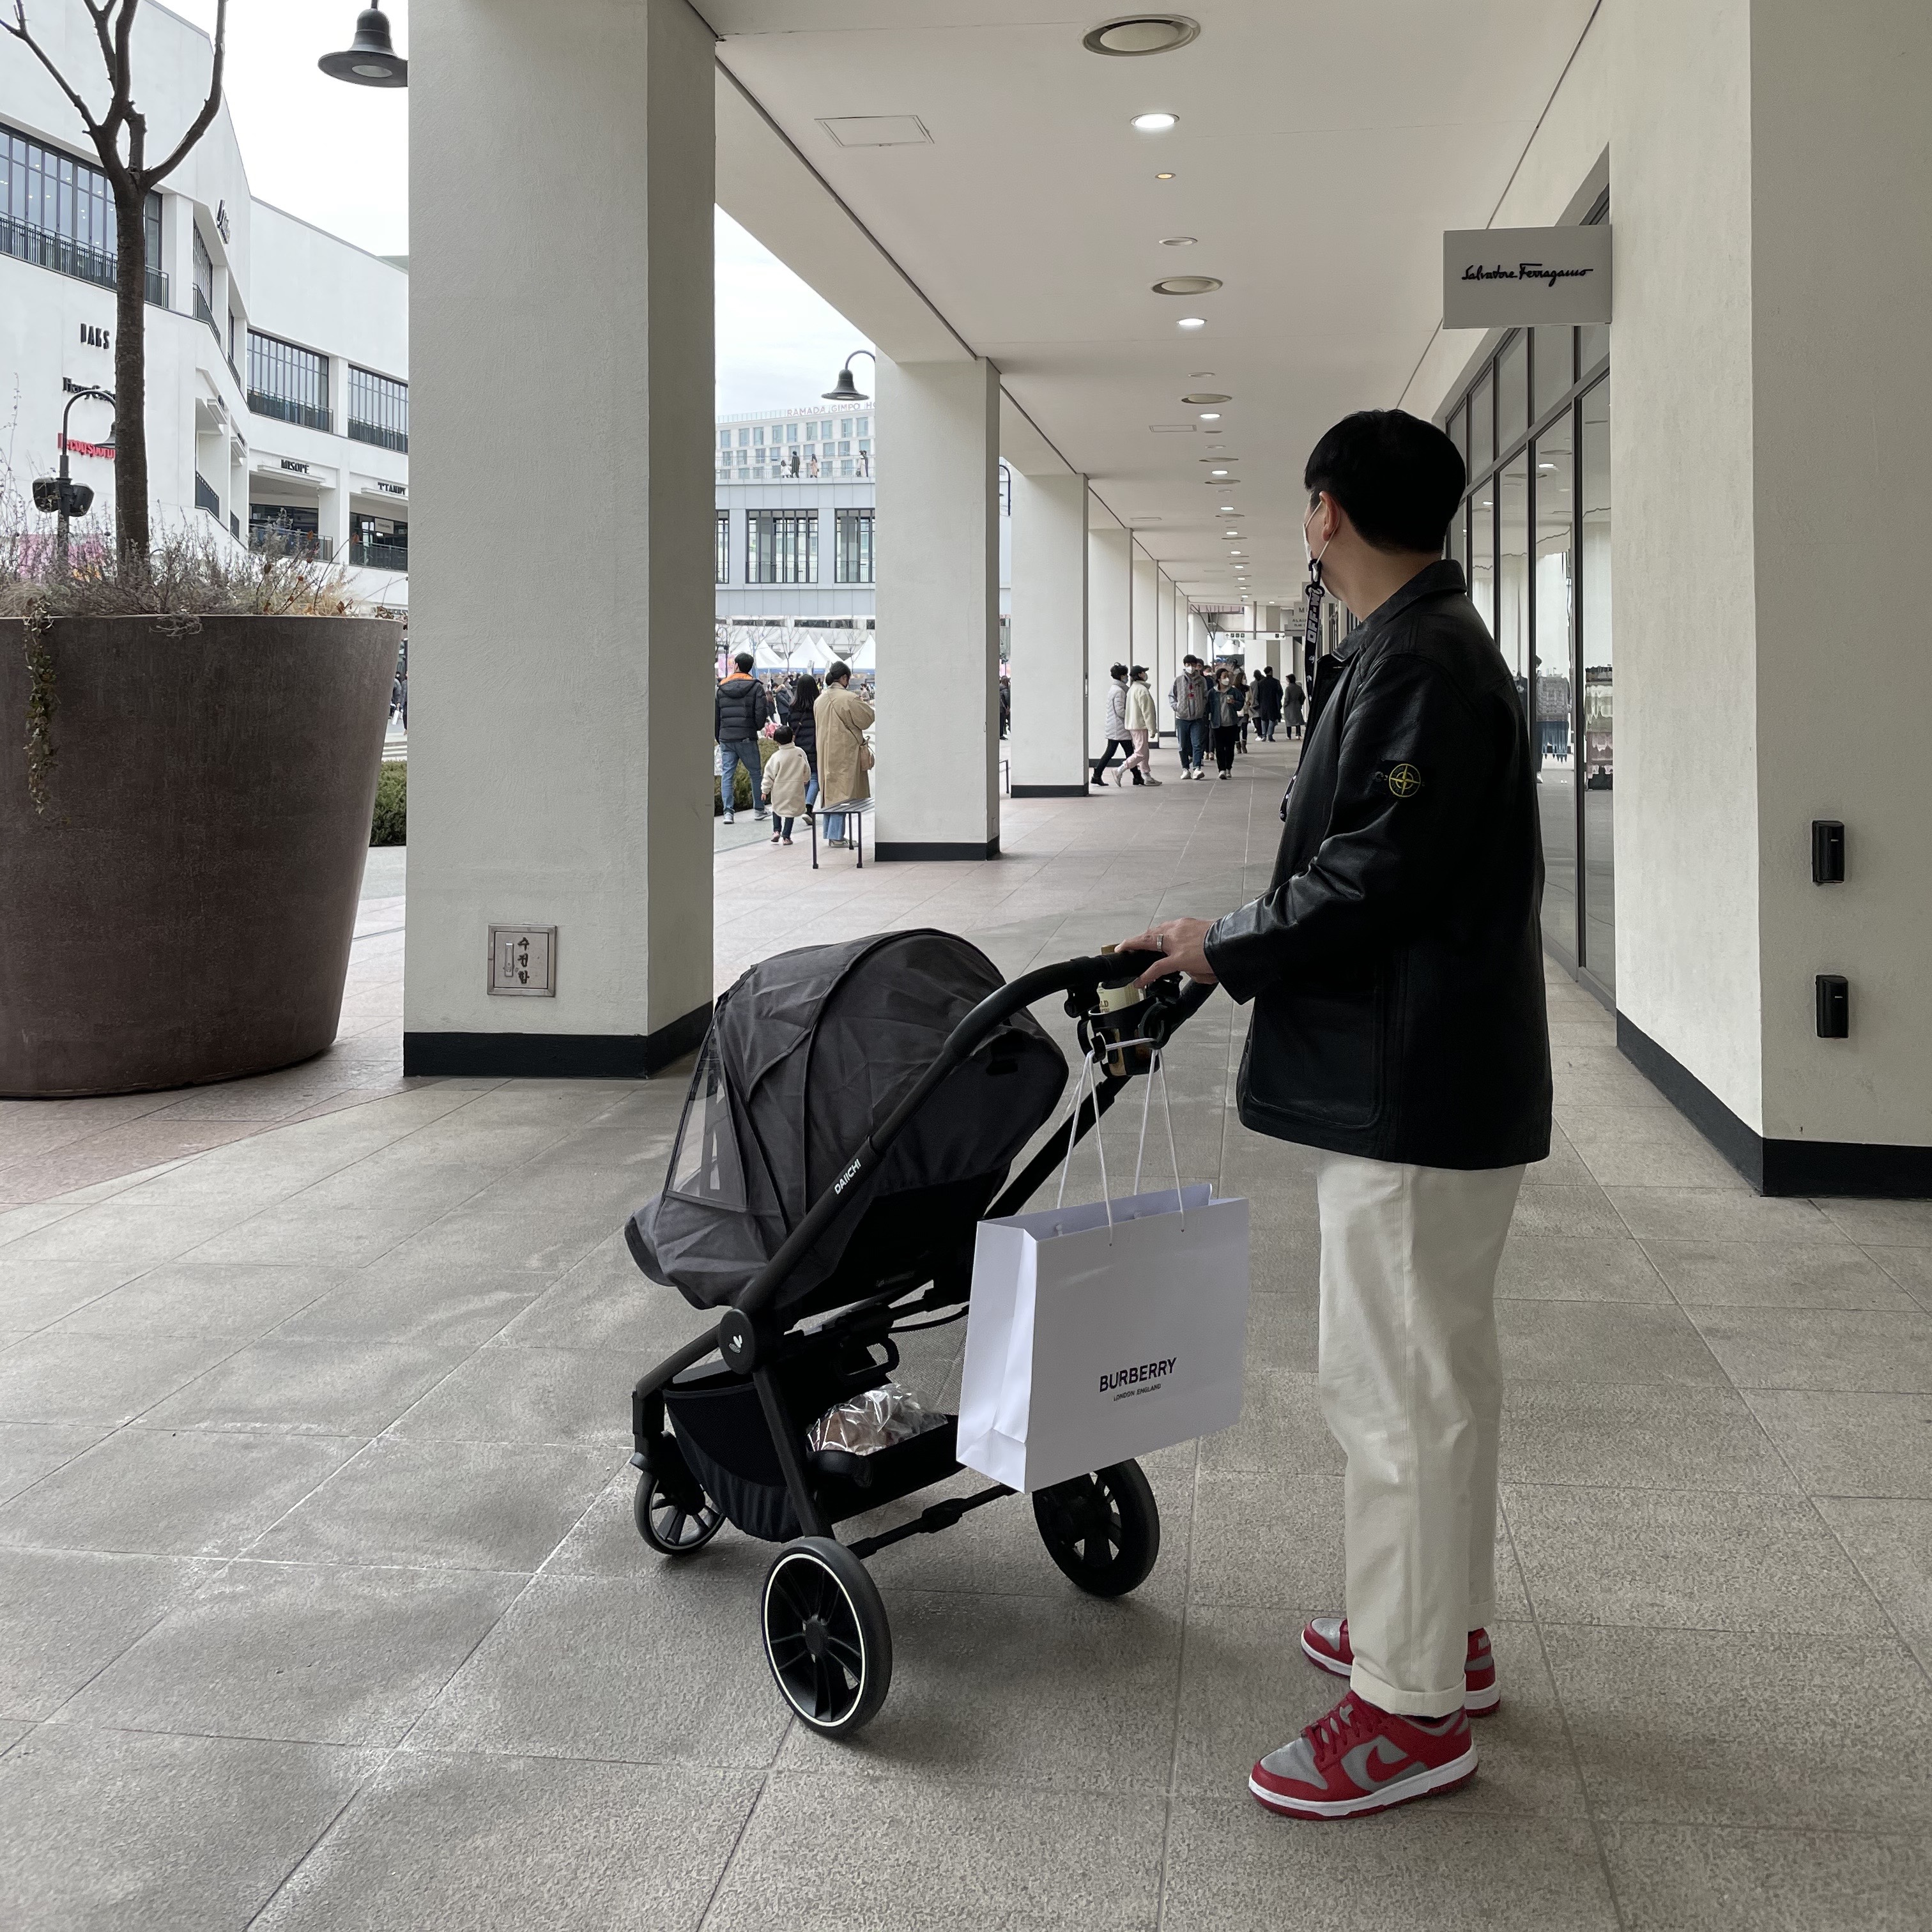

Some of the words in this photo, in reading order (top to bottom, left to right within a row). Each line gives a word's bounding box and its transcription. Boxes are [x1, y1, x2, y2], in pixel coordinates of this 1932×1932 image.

[1461, 264, 1517, 280] Salvatore
[1519, 263, 1594, 287] Ferragamo
[80, 323, 110, 349] DAKS
[786, 406, 825, 417] RAMADA
[831, 402, 861, 412] GIMPO
[834, 1158, 861, 1195] DAIICHI
[1100, 1357, 1177, 1392] BURBERRY
[1113, 1390, 1135, 1402] LONDON
[1137, 1383, 1162, 1395] ENGLAND
